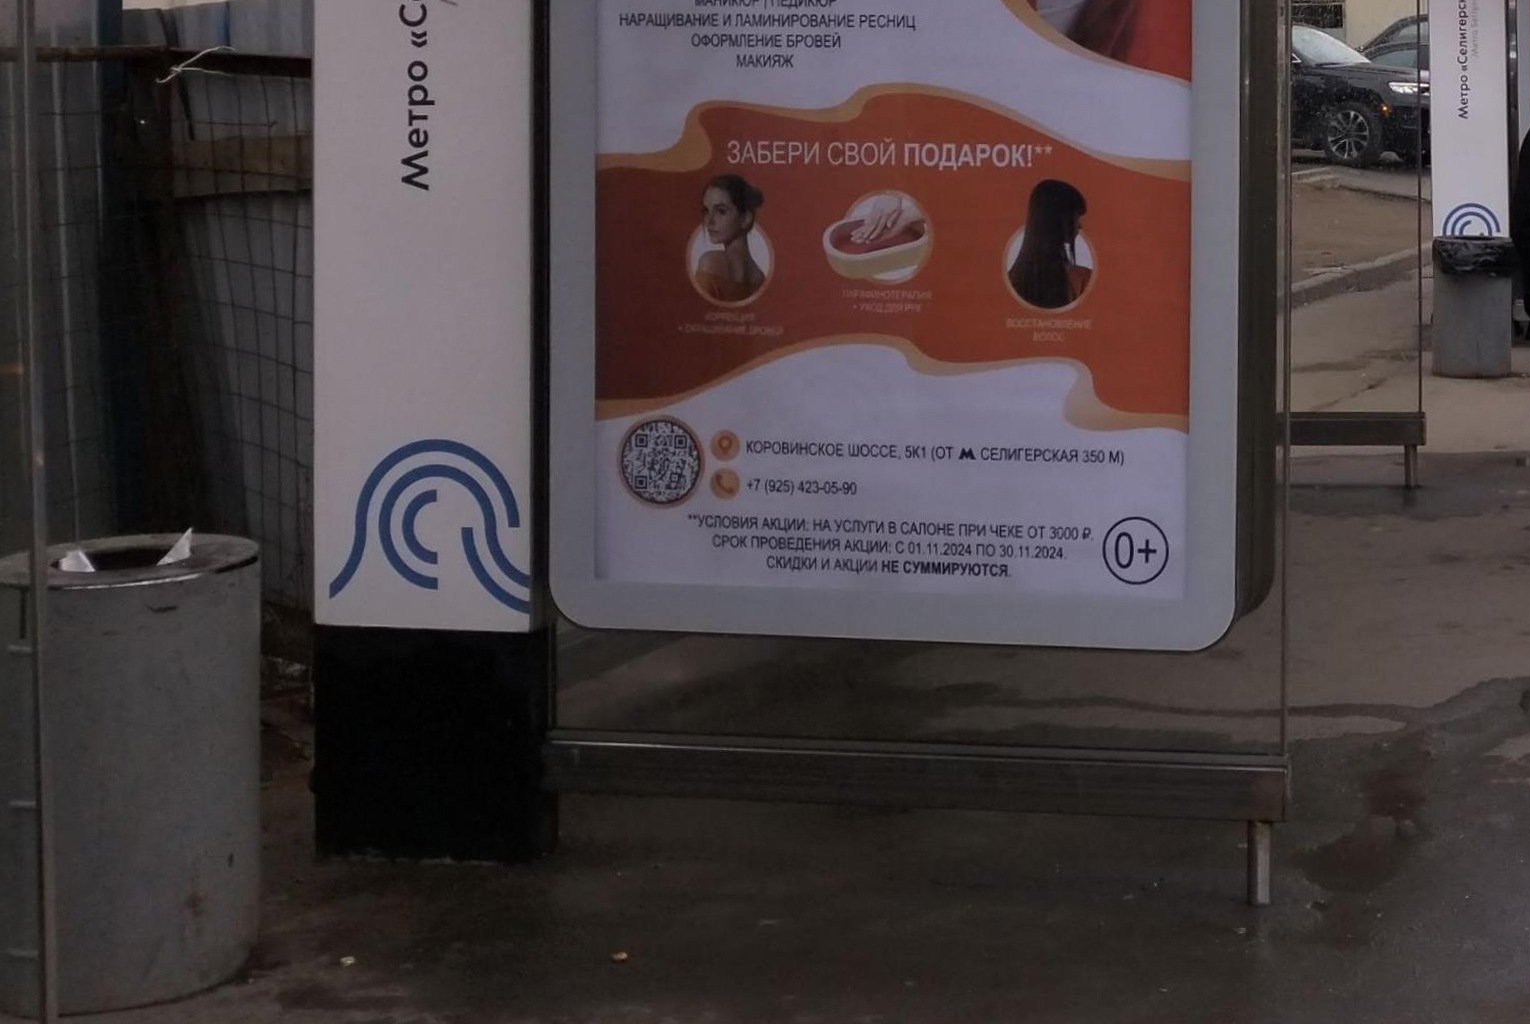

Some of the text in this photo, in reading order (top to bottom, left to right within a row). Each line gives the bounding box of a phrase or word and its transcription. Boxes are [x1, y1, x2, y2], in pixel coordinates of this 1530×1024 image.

[618, 13, 916, 31] НАРАЩИВАНИЕ И ЛАМИНИРОВАНИЕ РЕСНИЦ
[691, 32, 842, 48] ОФОРМЛЕНИЕ БРОВЕЙ
[736, 54, 795, 69] МАКИЯЖ
[1458, 74, 1472, 120] Метро
[400, 58, 436, 193] Метро
[727, 140, 820, 165] ЗАБЕРИ
[827, 138, 896, 166] СВОЙ
[745, 441, 844, 457] КОРОВИНСКОЕ
[847, 443, 901, 460] ШОССЕ,
[904, 445, 927, 459] 5К1
[931, 445, 954, 462] (ОТ
[980, 446, 1079, 463] СЕЛИГЕРСКАЯ
[1082, 449, 1105, 463] 350
[1108, 449, 1125, 467] М)
[746, 479, 858, 495] +7 (925) 423-05-90
[761, 517, 810, 533] АКЦИИ:
[812, 519, 832, 533] НА
[834, 519, 885, 534] УСЛУГИ
[888, 521, 897, 534] В
[900, 521, 954, 536] САЛОНЕ
[958, 523, 986, 537] ПРИ
[989, 525, 1023, 539] ЧЕКЕ
[1027, 526, 1047, 539] ОТ
[1049, 527, 1079, 540] 3000
[712, 533, 1067, 560] СРОК ПРОВЕДЕНИЯ АКЦИИ: С 01.11.2024 ПО 30.11.2024.
[1114, 531, 1158, 570] 0+
[766, 555, 1012, 578] СКИДКИ И АКЦИИ НЕ СУММИРУЮТСЯ.
